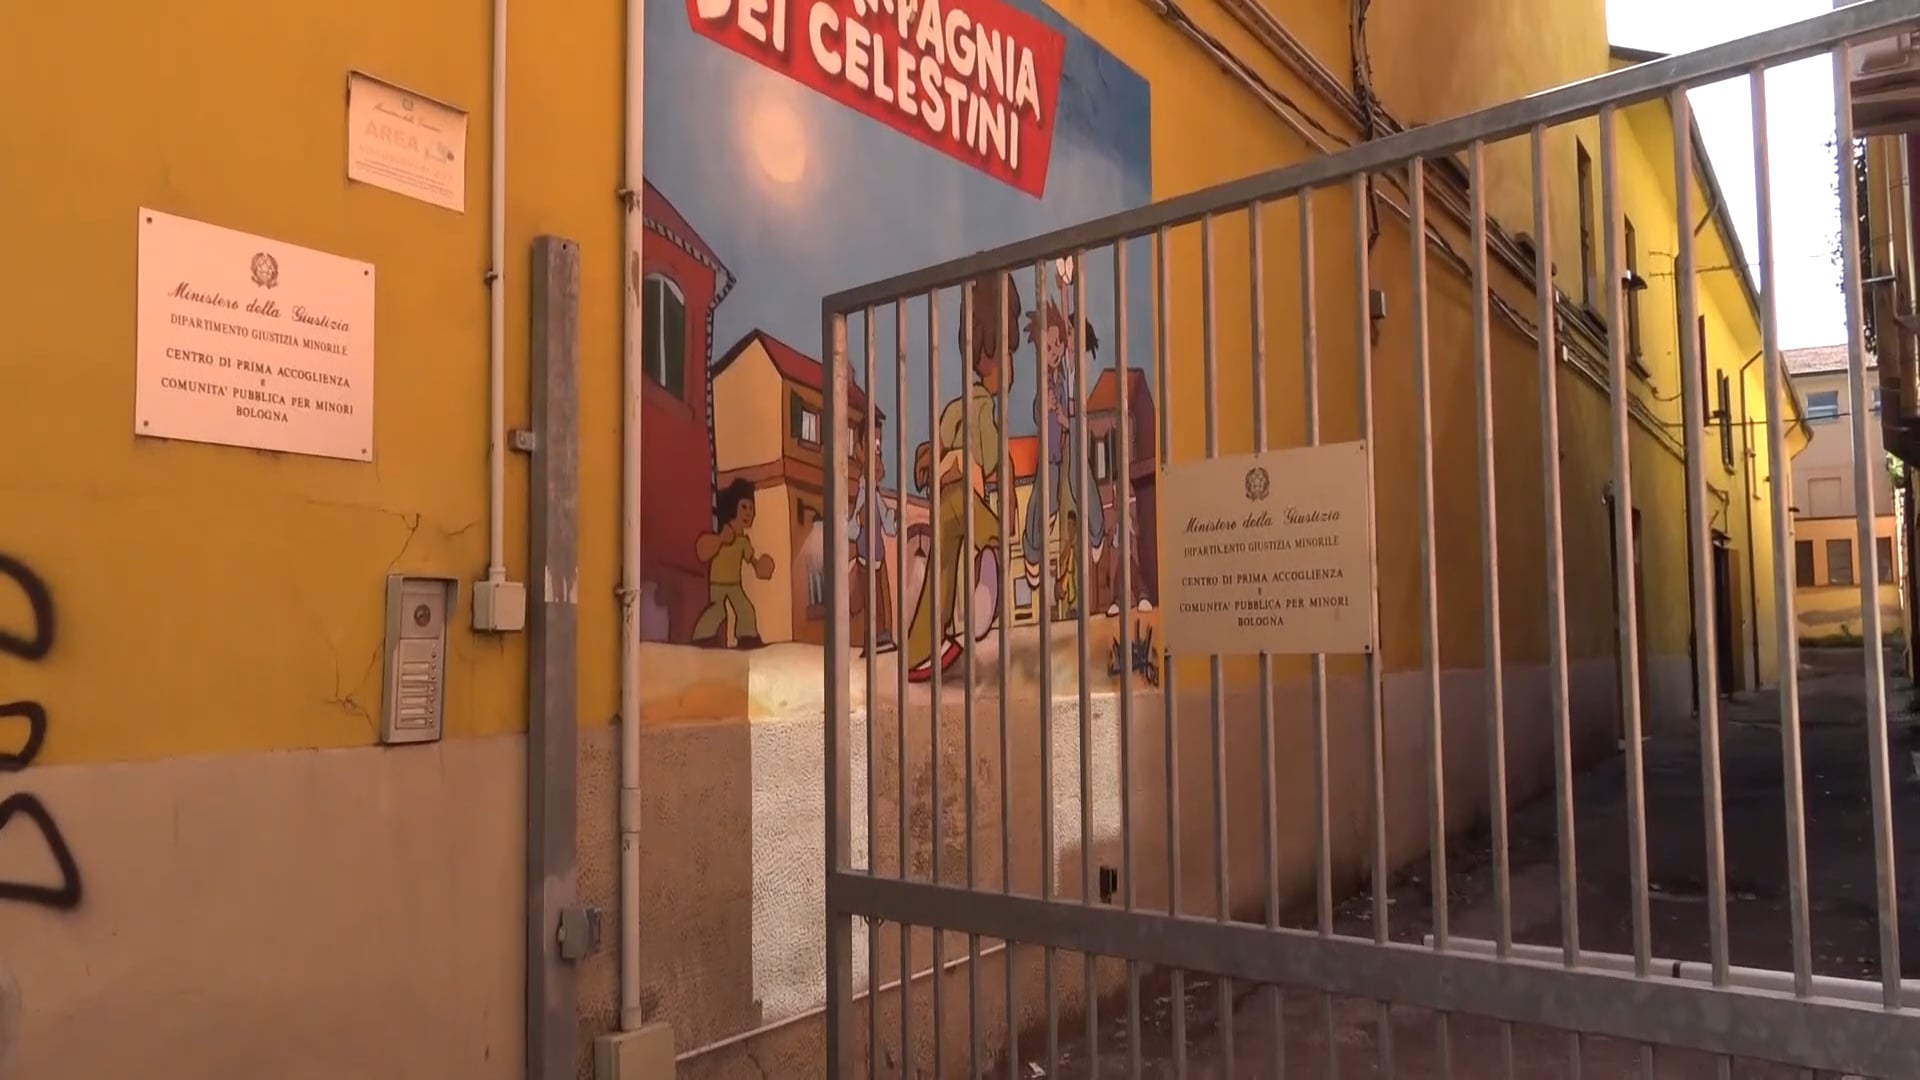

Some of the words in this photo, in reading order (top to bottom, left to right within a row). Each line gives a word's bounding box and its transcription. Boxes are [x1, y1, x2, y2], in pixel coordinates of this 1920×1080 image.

[853, 0, 1041, 121] PAGNIA
[809, 1, 1018, 169] CELESTINI
[364, 119, 420, 153] AREA
[168, 281, 239, 310] Ministero
[246, 298, 281, 318] della
[291, 305, 349, 332] Giustizia
[170, 313, 248, 337] DIPARTIMENTO
[251, 328, 299, 347] GIUSTIZIA
[302, 338, 348, 356] MINORILE
[166, 347, 214, 366] CENTRO
[218, 356, 231, 368] DI
[237, 359, 272, 375] PRIMA
[277, 366, 350, 388] ACCOGLIENZA
[260, 378, 266, 387] E
[233, 387, 286, 405] PUBBLICA
[291, 397, 311, 409] PER
[315, 400, 353, 415] MINORI
[236, 405, 288, 422] BOLOGNA
[1183, 515, 1237, 534] Ministero
[1242, 511, 1273, 529] della
[1283, 506, 1340, 526] Giustizia
[1248, 538, 1291, 552] GIUSTIZIA
[1295, 535, 1340, 549] MINORILE
[1181, 575, 1218, 587] CENTRO
[1222, 574, 1232, 584] DI
[1236, 573, 1268, 585] PRIMA
[1272, 568, 1344, 583] ACCOGLIENZA
[1234, 599, 1281, 611] PUBBLICA
[1285, 597, 1304, 608] PER
[1309, 595, 1349, 608] MINORI
[1238, 616, 1284, 627] BOLOGNA
